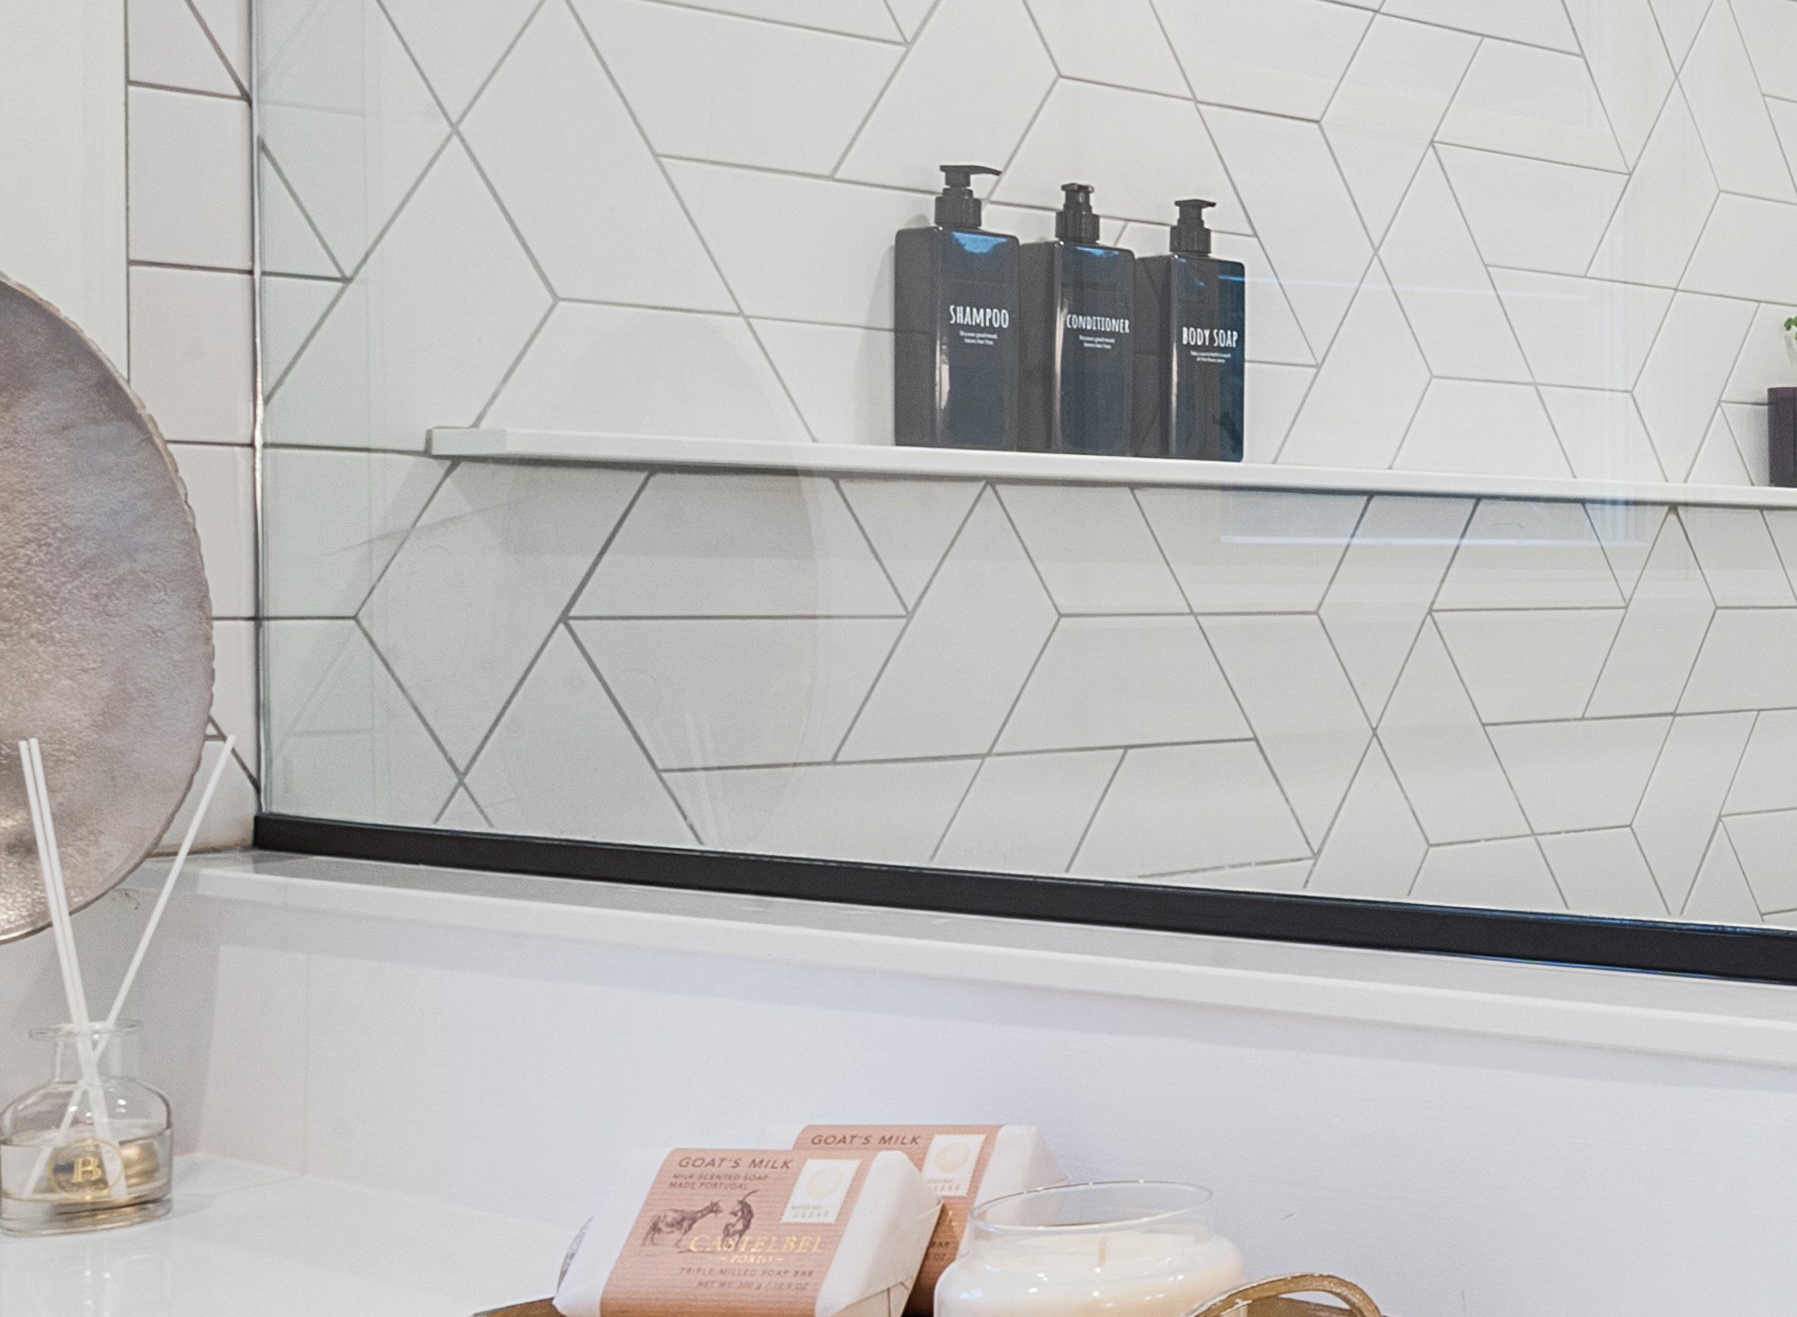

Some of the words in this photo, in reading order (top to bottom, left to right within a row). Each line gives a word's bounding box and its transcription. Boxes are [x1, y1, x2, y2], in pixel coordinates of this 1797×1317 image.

[949, 304, 1009, 329] SHAMPOO
[1066, 313, 1130, 334] CONDITIONER
[1182, 326, 1210, 346] BODY
[1213, 329, 1238, 348] SOAP
[811, 1134, 871, 1146] GOAT'S
[878, 1135, 922, 1146] MILK
[678, 1157, 742, 1169] GOAT'S
[747, 1158, 794, 1170] MILK
[673, 1173, 694, 1181] MILK
[700, 1173, 740, 1181] SCENTED
[744, 1174, 769, 1182] SOAP
[669, 1181, 698, 1190] MADE
[700, 1182, 748, 1191] PORTUGAL
[689, 1234, 823, 1253] CASTELBEL
[730, 1255, 773, 1264] PORTO
[761, 1268, 789, 1278] SOAP
[793, 1270, 815, 1278] BAR
